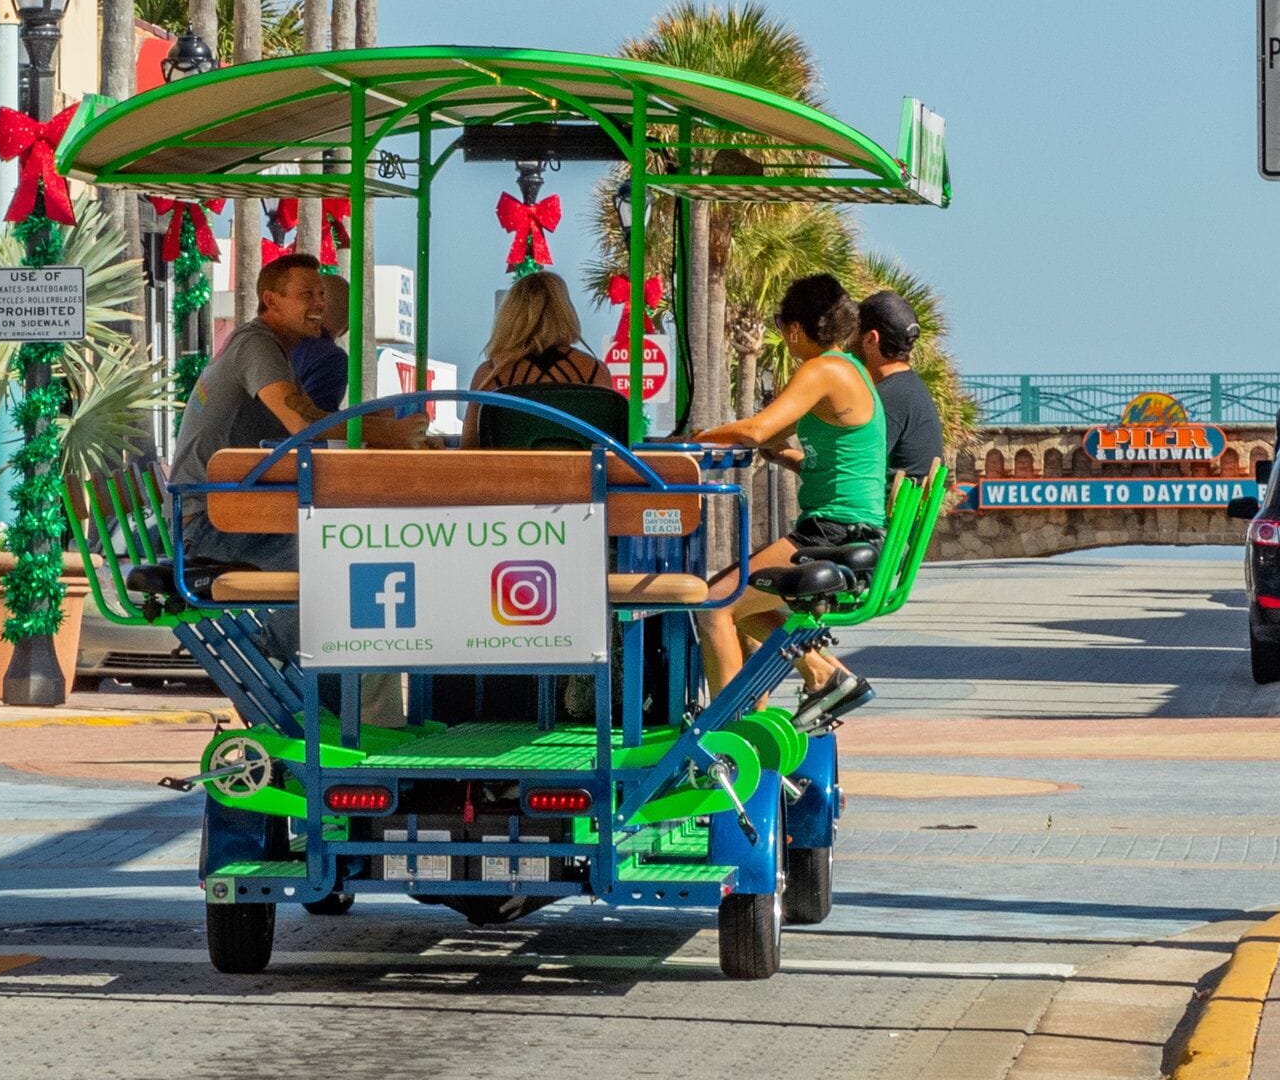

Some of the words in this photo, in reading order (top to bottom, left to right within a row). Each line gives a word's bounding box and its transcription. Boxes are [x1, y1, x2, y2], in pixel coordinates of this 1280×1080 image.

[10, 272, 37, 282] USE
[44, 271, 62, 281] OF
[1, 320, 15, 328] ON
[21, 319, 71, 328] SIDEWALK
[612, 349, 629, 360] DO
[642, 349, 658, 360] OT
[616, 378, 654, 389] ENER
[1097, 427, 1210, 449] PIER
[1096, 449, 1106, 460] &
[1115, 448, 1213, 460] BOARDWALK
[987, 484, 1091, 503] WELCOME
[1103, 484, 1130, 503] TO
[1142, 483, 1244, 502] DAYTONA
[322, 522, 457, 548] FOLLOW
[467, 522, 508, 546] US
[517, 521, 566, 545] ON
[322, 639, 433, 653] @HOPCYCLES
[466, 636, 573, 650] #HOPCYCLES
